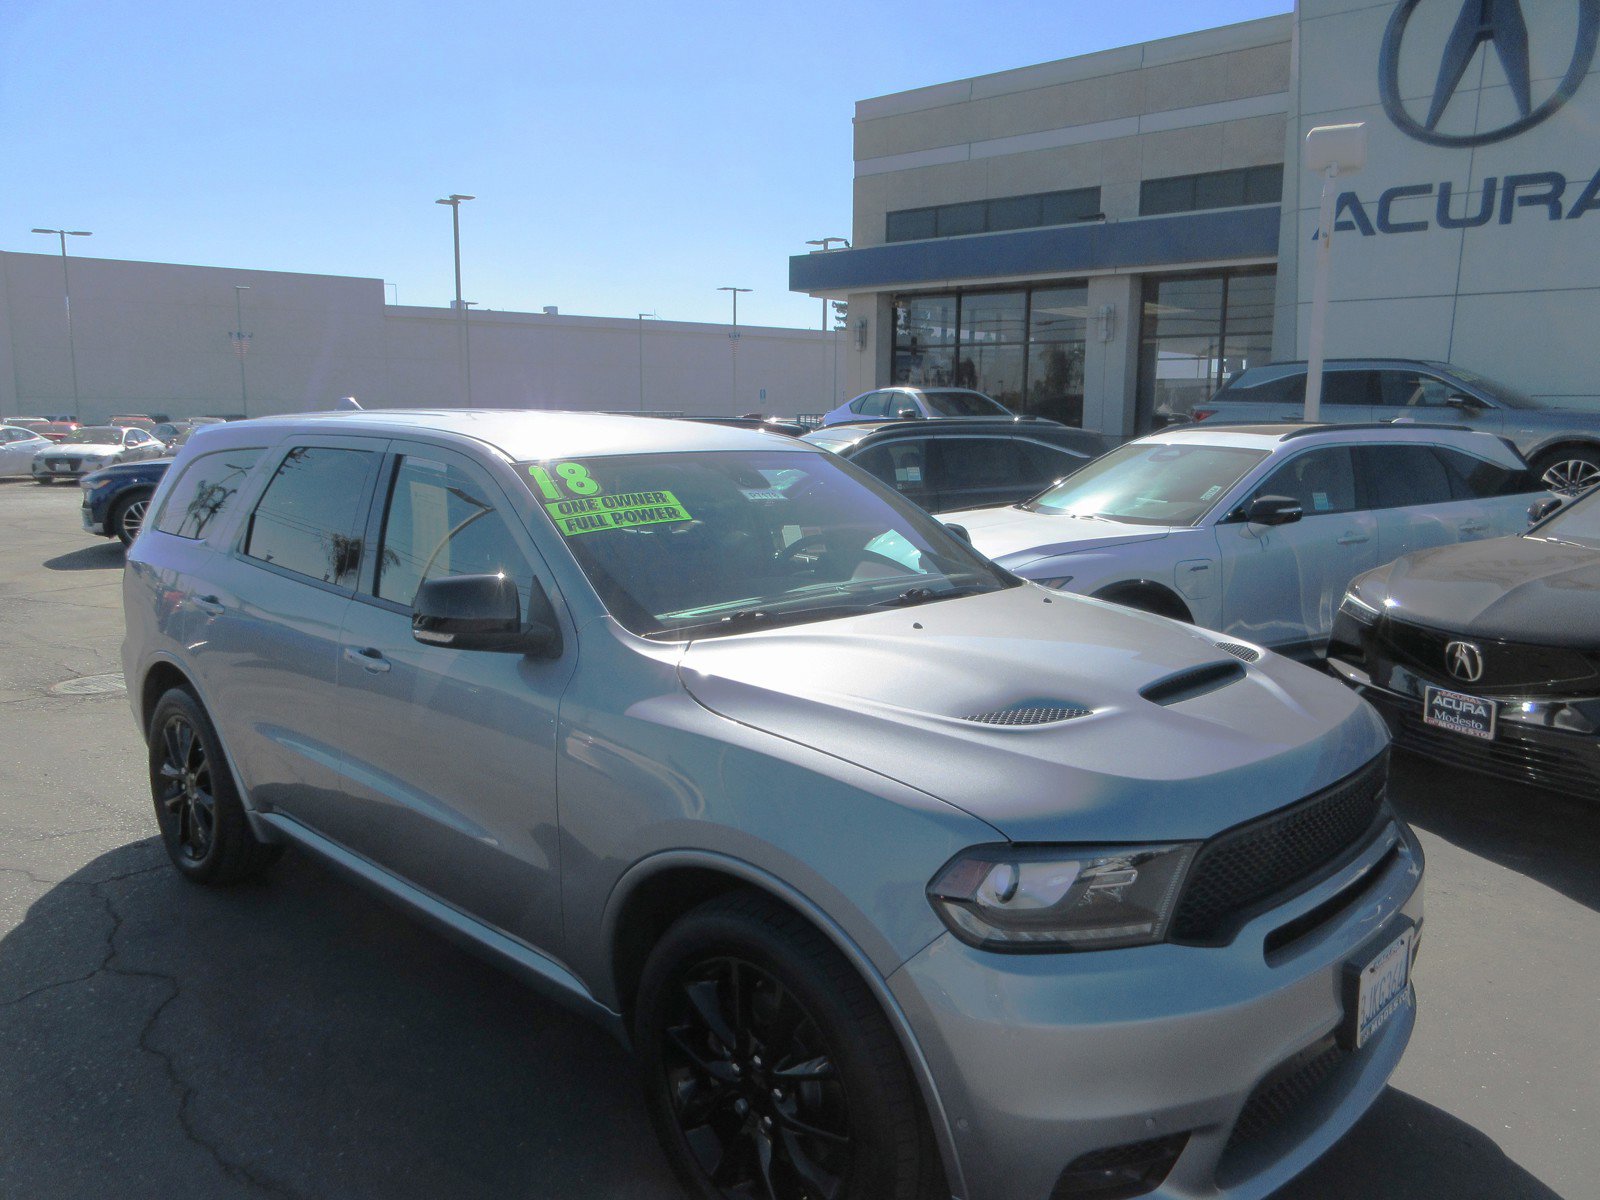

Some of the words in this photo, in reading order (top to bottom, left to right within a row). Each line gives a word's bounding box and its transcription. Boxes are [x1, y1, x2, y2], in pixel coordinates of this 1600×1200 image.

[528, 462, 598, 499] 18
[557, 498, 599, 516] ONE
[601, 491, 669, 510] OWNER
[565, 514, 610, 532] FULL
[611, 506, 681, 526] POWER
[1432, 695, 1487, 718] ACURA
[1434, 709, 1483, 730] Modesto
